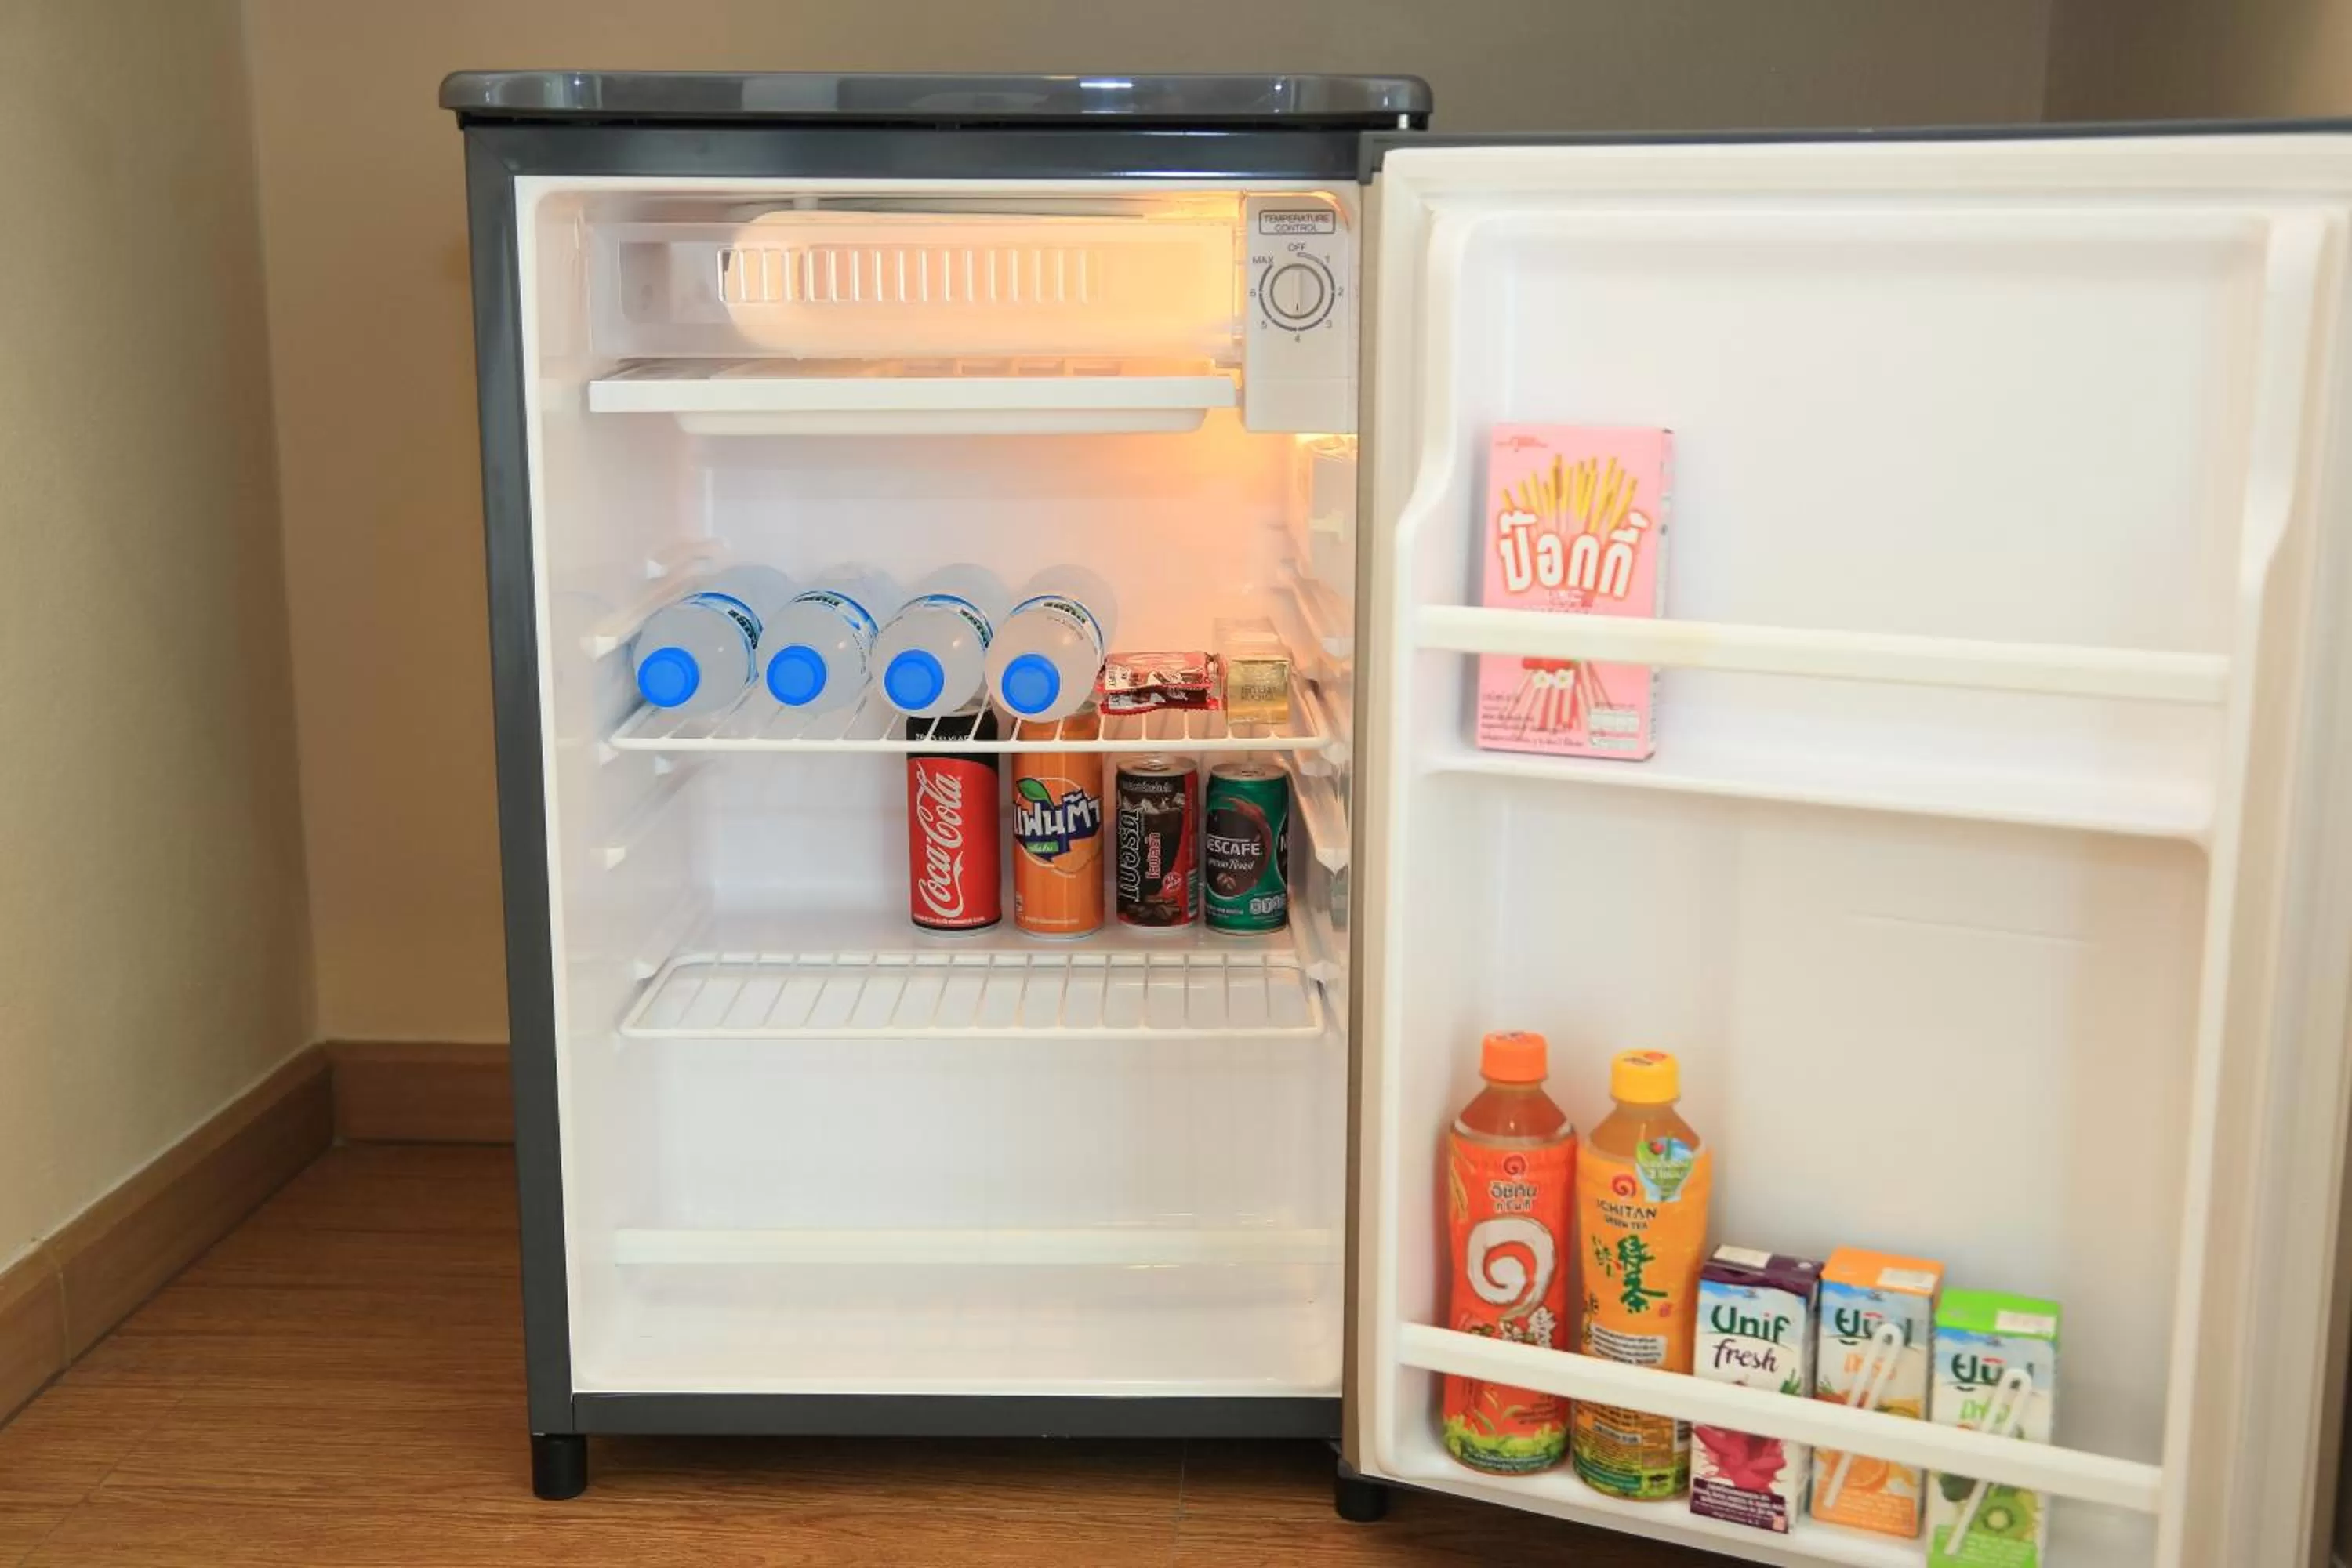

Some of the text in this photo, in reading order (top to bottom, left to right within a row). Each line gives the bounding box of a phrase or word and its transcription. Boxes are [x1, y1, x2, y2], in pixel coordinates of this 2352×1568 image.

[1264, 214, 1330, 223] TEMPERATURE
[1275, 224, 1317, 233] CONTROL
[1288, 243, 1306, 252] OFF
[1252, 256, 1275, 264] MAX
[1338, 287, 1344, 297] 2
[1326, 320, 1332, 329] 3
[1294, 334, 1301, 343] 4
[916, 760, 964, 917] Coca-Cola
[1596, 1197, 1657, 1221] ICHITAN
[1711, 1304, 1791, 1345] Unif
[1712, 1337, 1780, 1373] fresh
